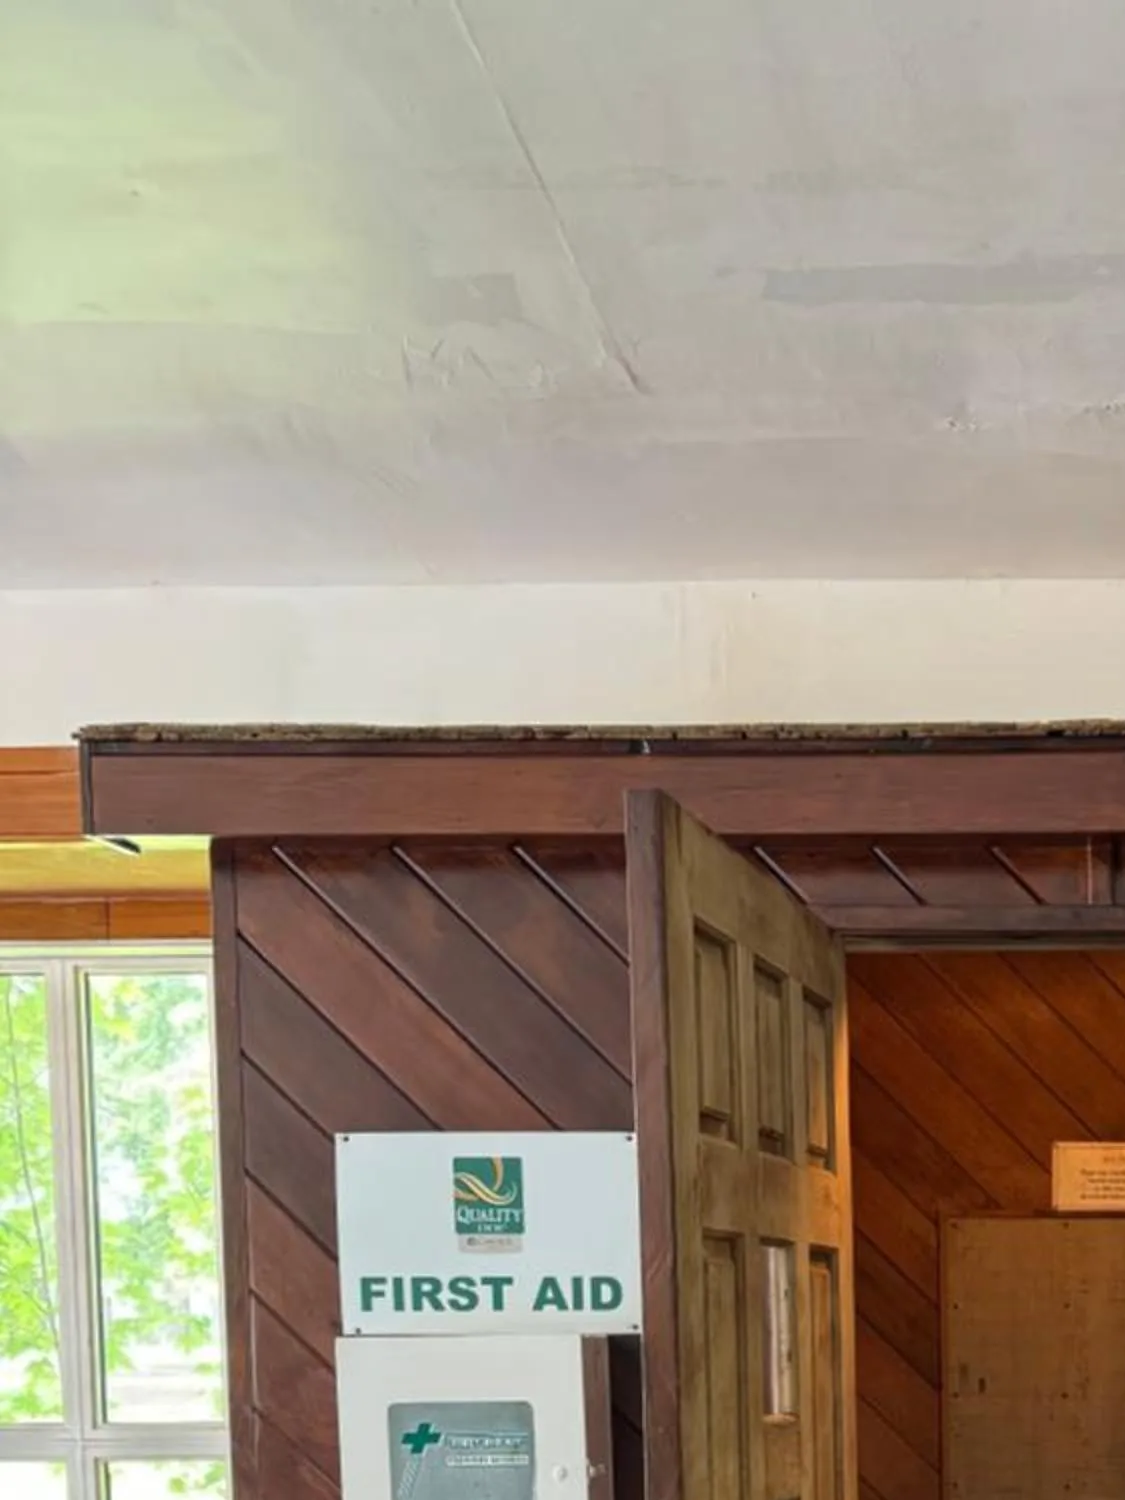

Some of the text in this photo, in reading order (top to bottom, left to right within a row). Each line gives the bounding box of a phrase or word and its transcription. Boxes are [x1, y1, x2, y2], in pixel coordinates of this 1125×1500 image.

[457, 1206, 523, 1225] QUALITY
[359, 1276, 624, 1313] FIRST AID
